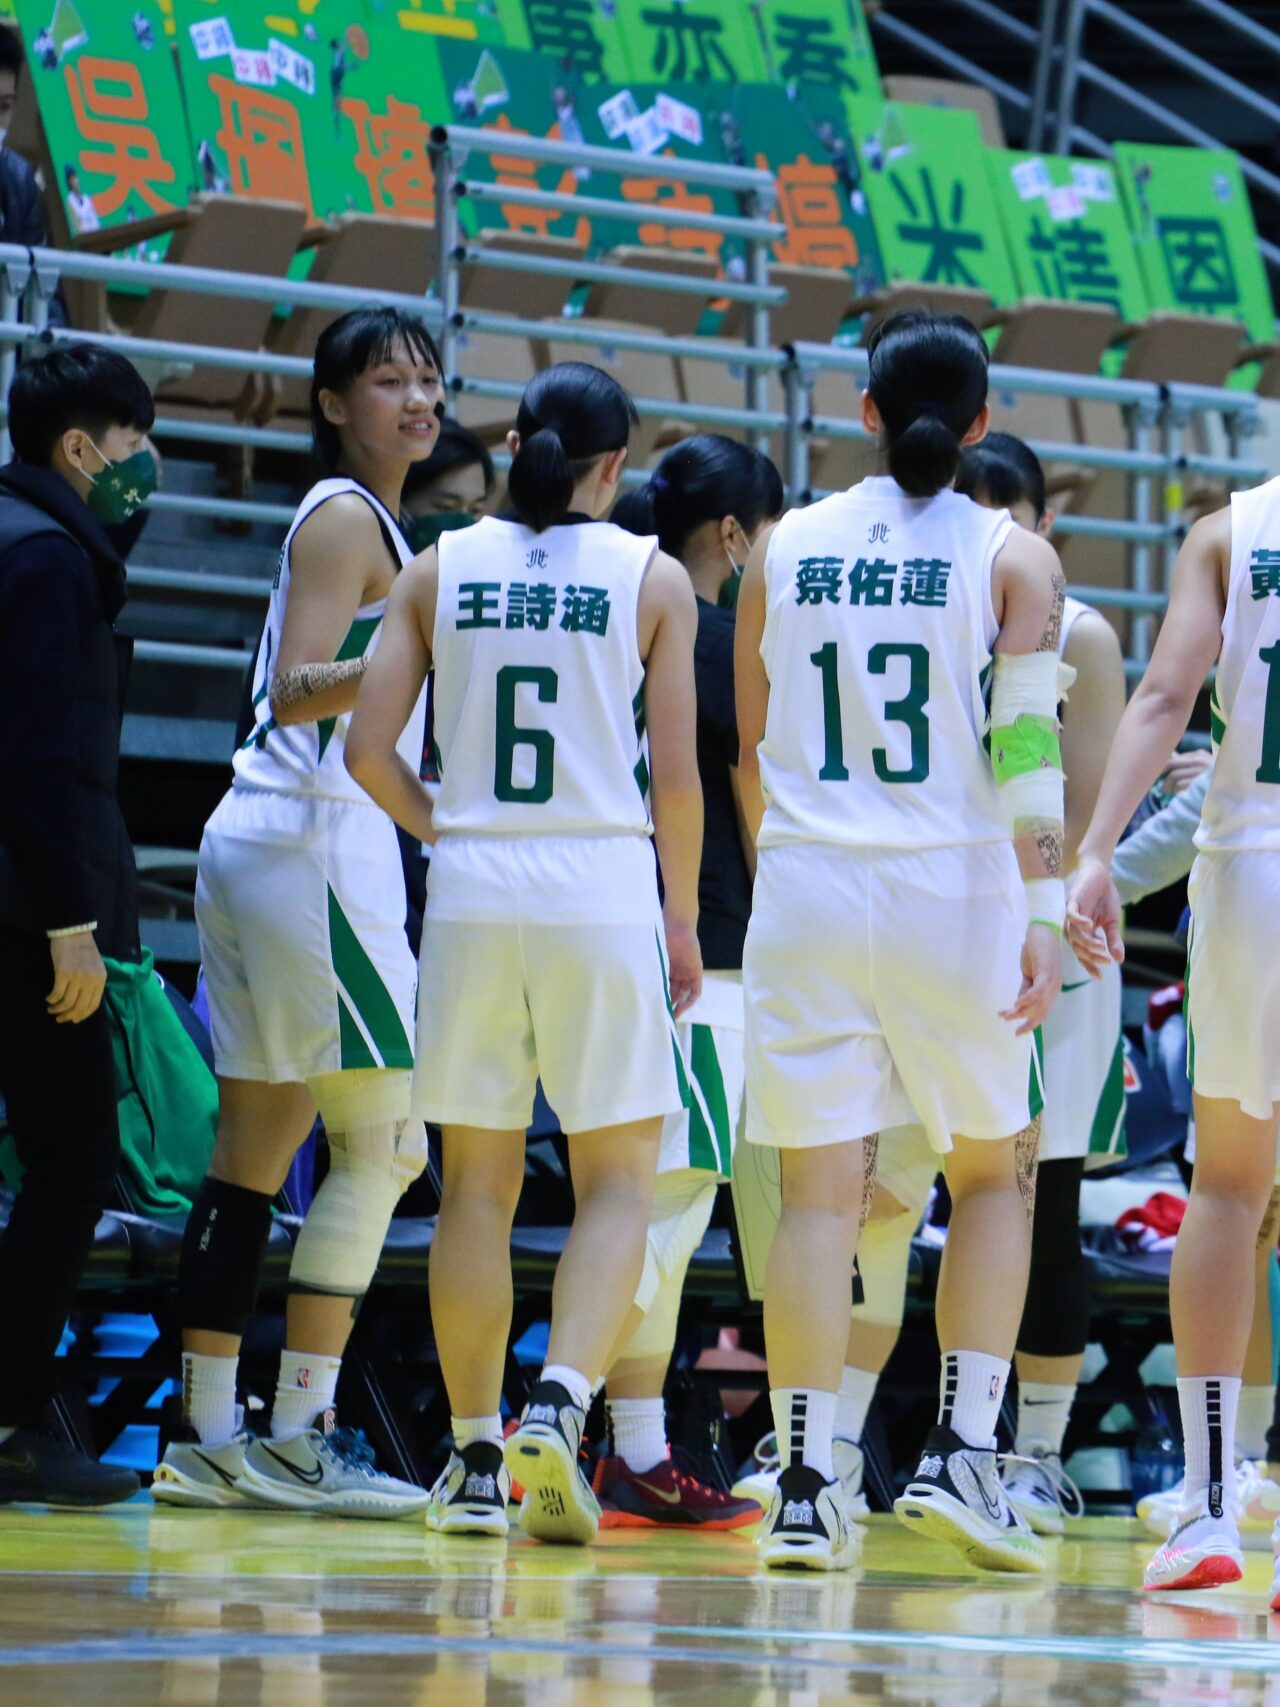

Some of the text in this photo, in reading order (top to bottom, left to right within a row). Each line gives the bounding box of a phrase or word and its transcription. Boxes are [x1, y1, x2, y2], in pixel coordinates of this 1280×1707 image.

[456, 582, 611, 637] 王詩涵
[795, 556, 952, 607] 蔡佑蓮
[494, 665, 558, 804] 6
[810, 642, 930, 784] 13
